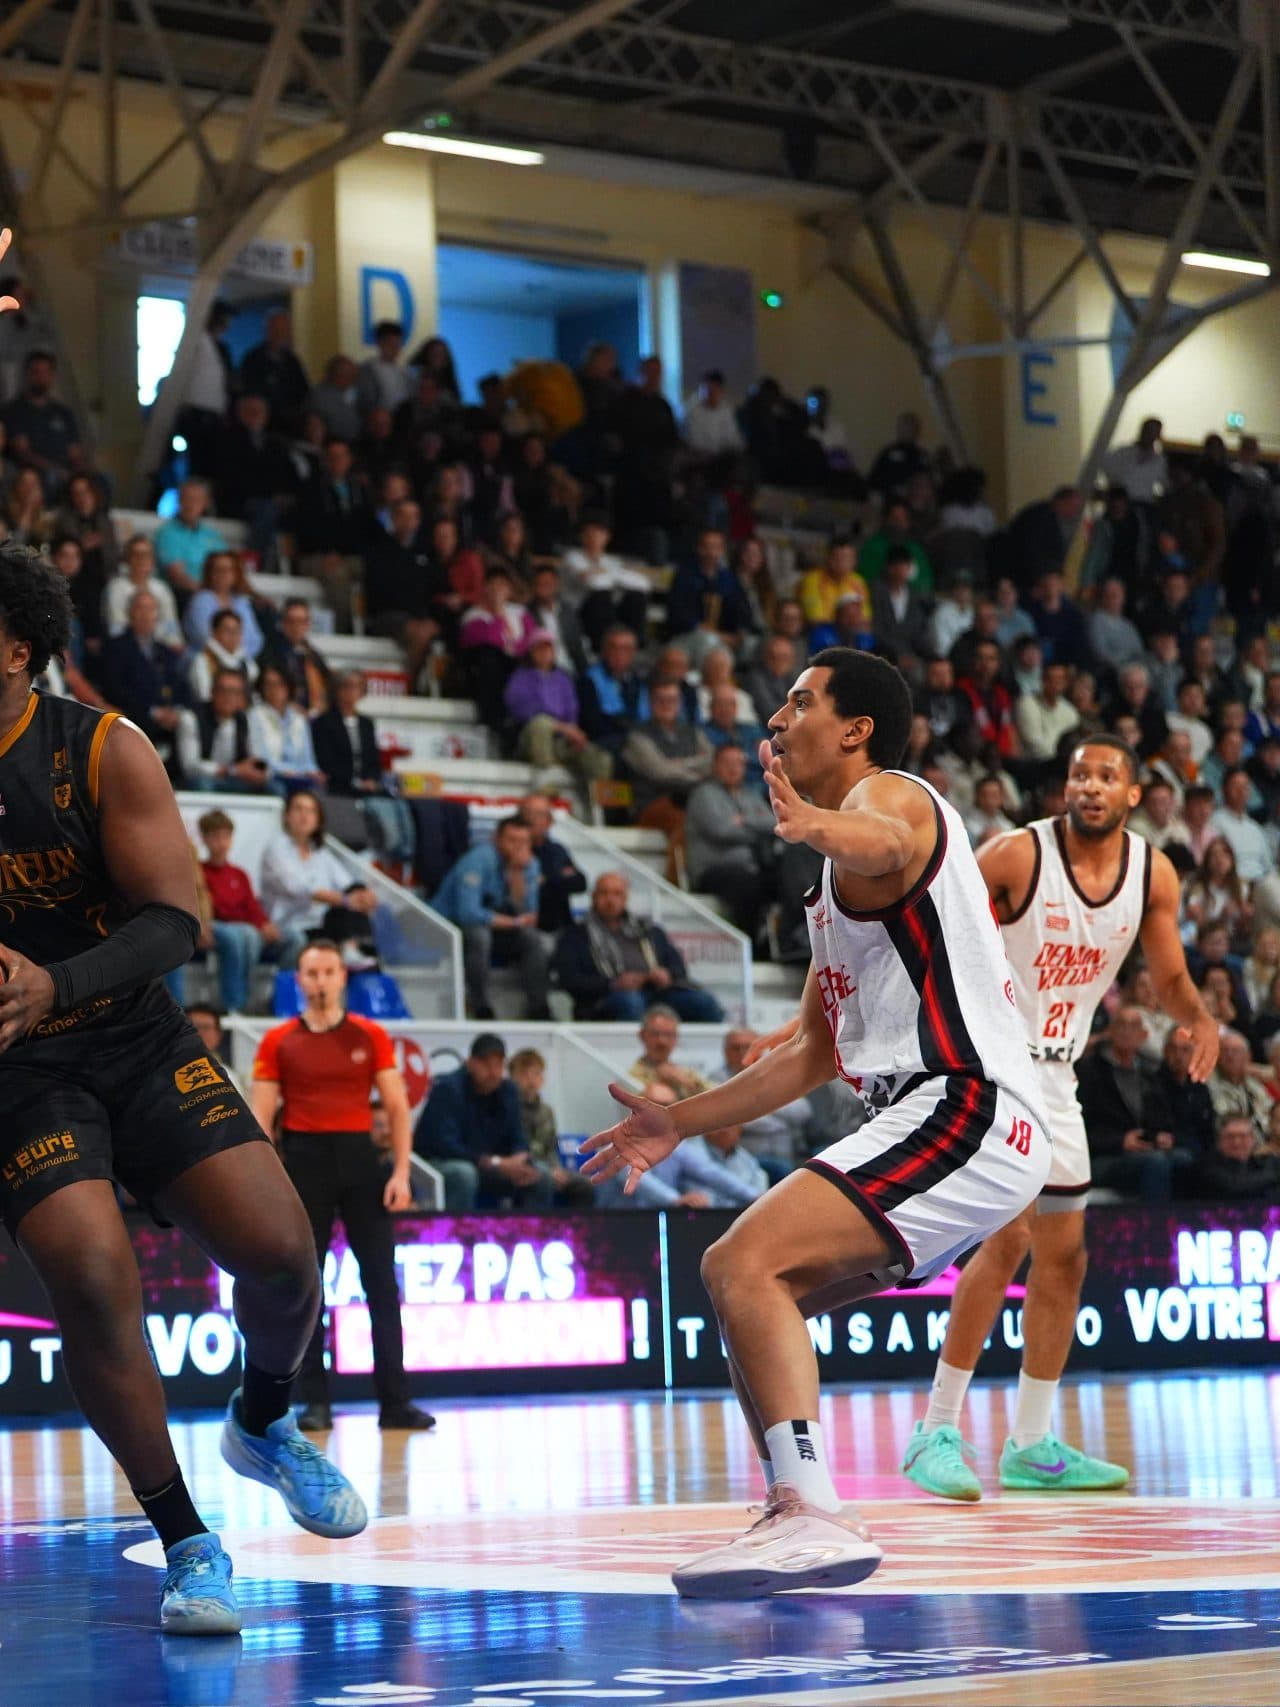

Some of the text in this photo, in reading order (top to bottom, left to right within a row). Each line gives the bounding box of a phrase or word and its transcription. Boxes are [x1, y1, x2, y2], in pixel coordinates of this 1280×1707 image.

[358, 264, 414, 346] D
[1019, 351, 1057, 428] E
[86, 903, 110, 937] 7
[1043, 1002, 1075, 1039] 21
[1006, 1115, 1033, 1156] 18
[472, 1241, 576, 1304] PAS
[1177, 1230, 1234, 1286] NE
[631, 1298, 649, 1359] !
[1124, 1287, 1265, 1343] VOTRE
[794, 1437, 817, 1462] NIKE
